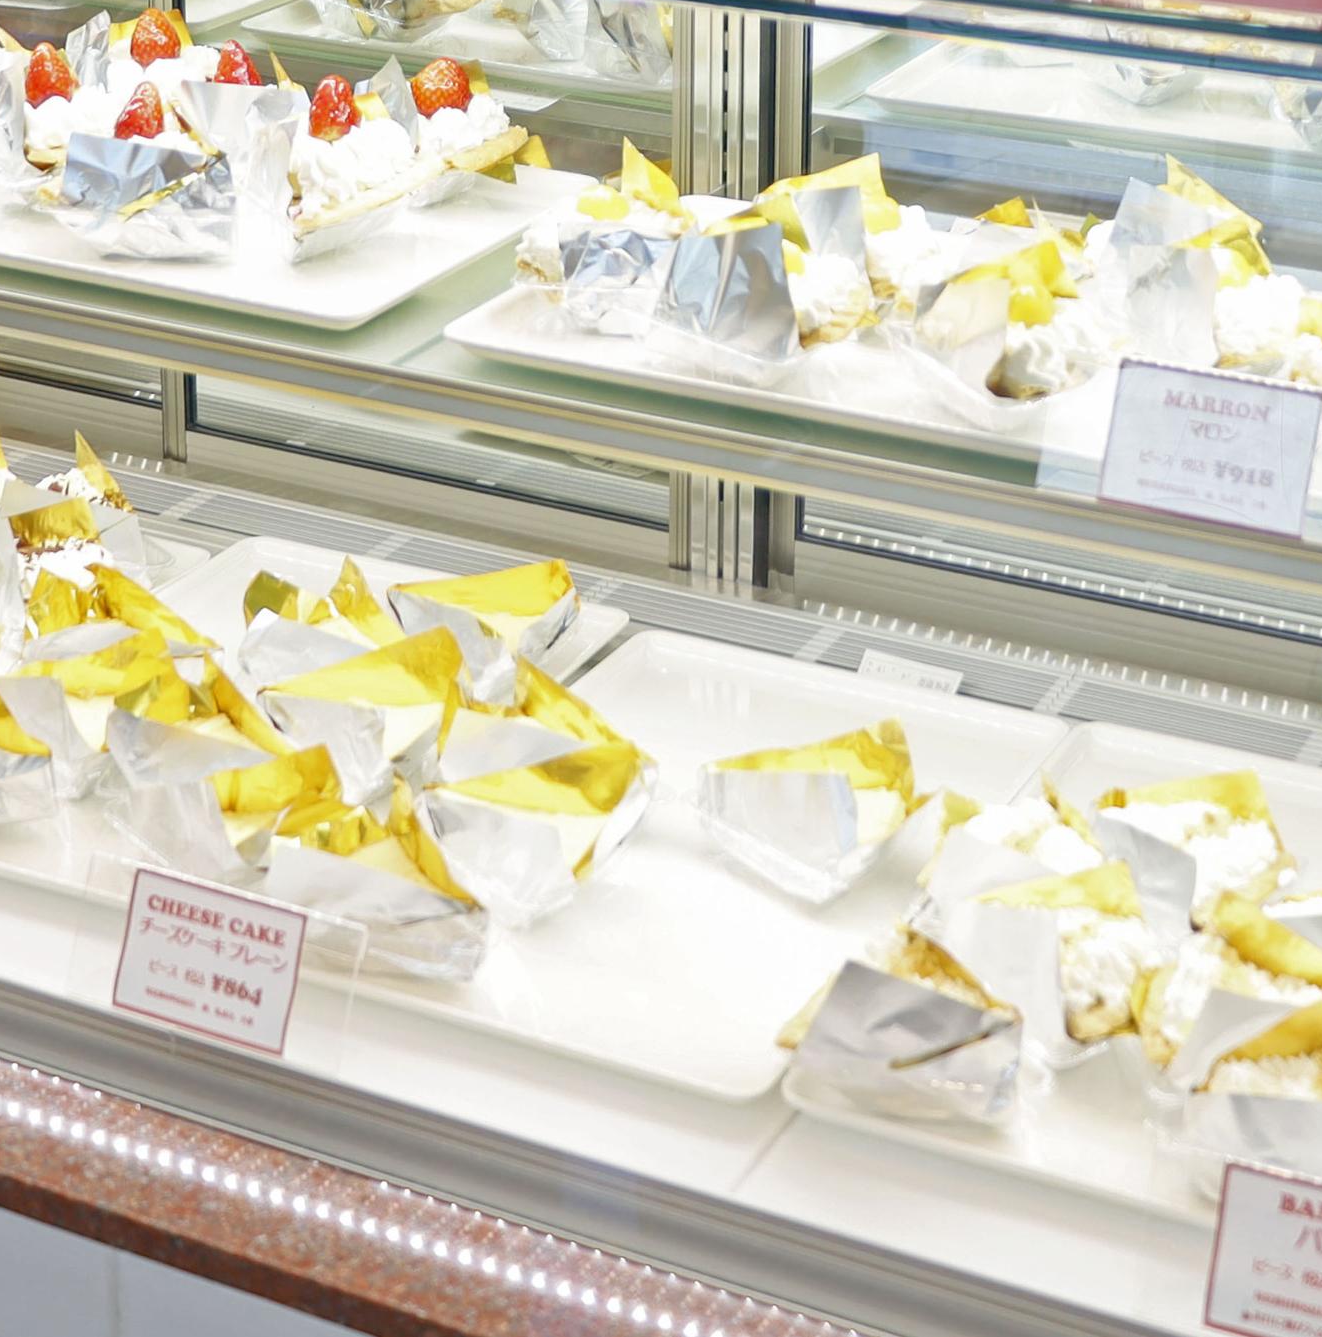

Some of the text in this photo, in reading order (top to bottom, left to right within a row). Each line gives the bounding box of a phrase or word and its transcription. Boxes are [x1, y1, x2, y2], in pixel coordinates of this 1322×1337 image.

[1163, 388, 1272, 423] MARRON
[1188, 419, 1238, 441] マロン
[1213, 459, 1275, 487] ¥918
[147, 894, 286, 946] CHEESE CAKE
[139, 916, 289, 973] チーズケーキ プレーン
[211, 973, 264, 1007] ¥864
